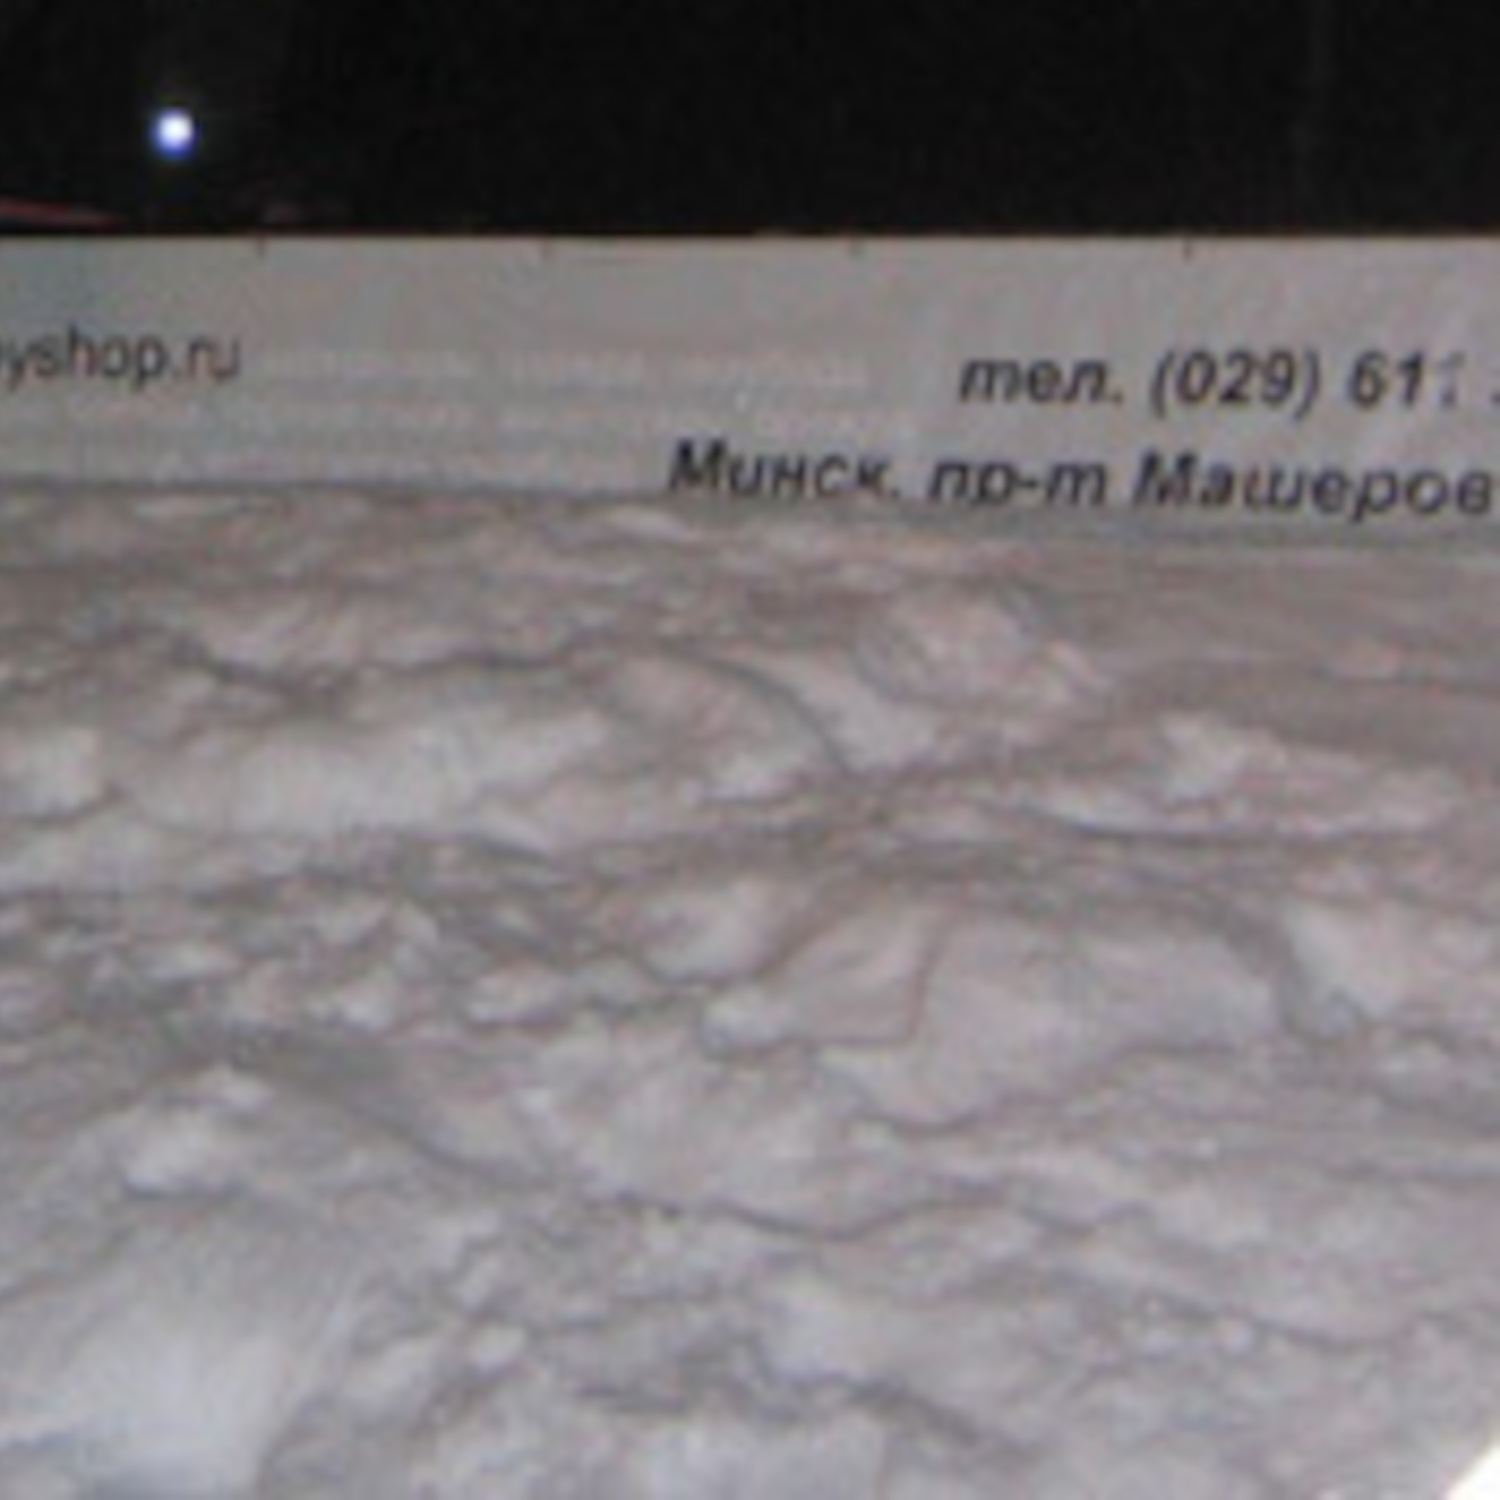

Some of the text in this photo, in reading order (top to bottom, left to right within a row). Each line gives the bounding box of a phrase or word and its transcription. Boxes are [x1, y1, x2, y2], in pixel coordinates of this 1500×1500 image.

[957, 354, 1124, 406] тел.
[1150, 347, 1322, 420] (029)
[930, 457, 1108, 508] пр-т
